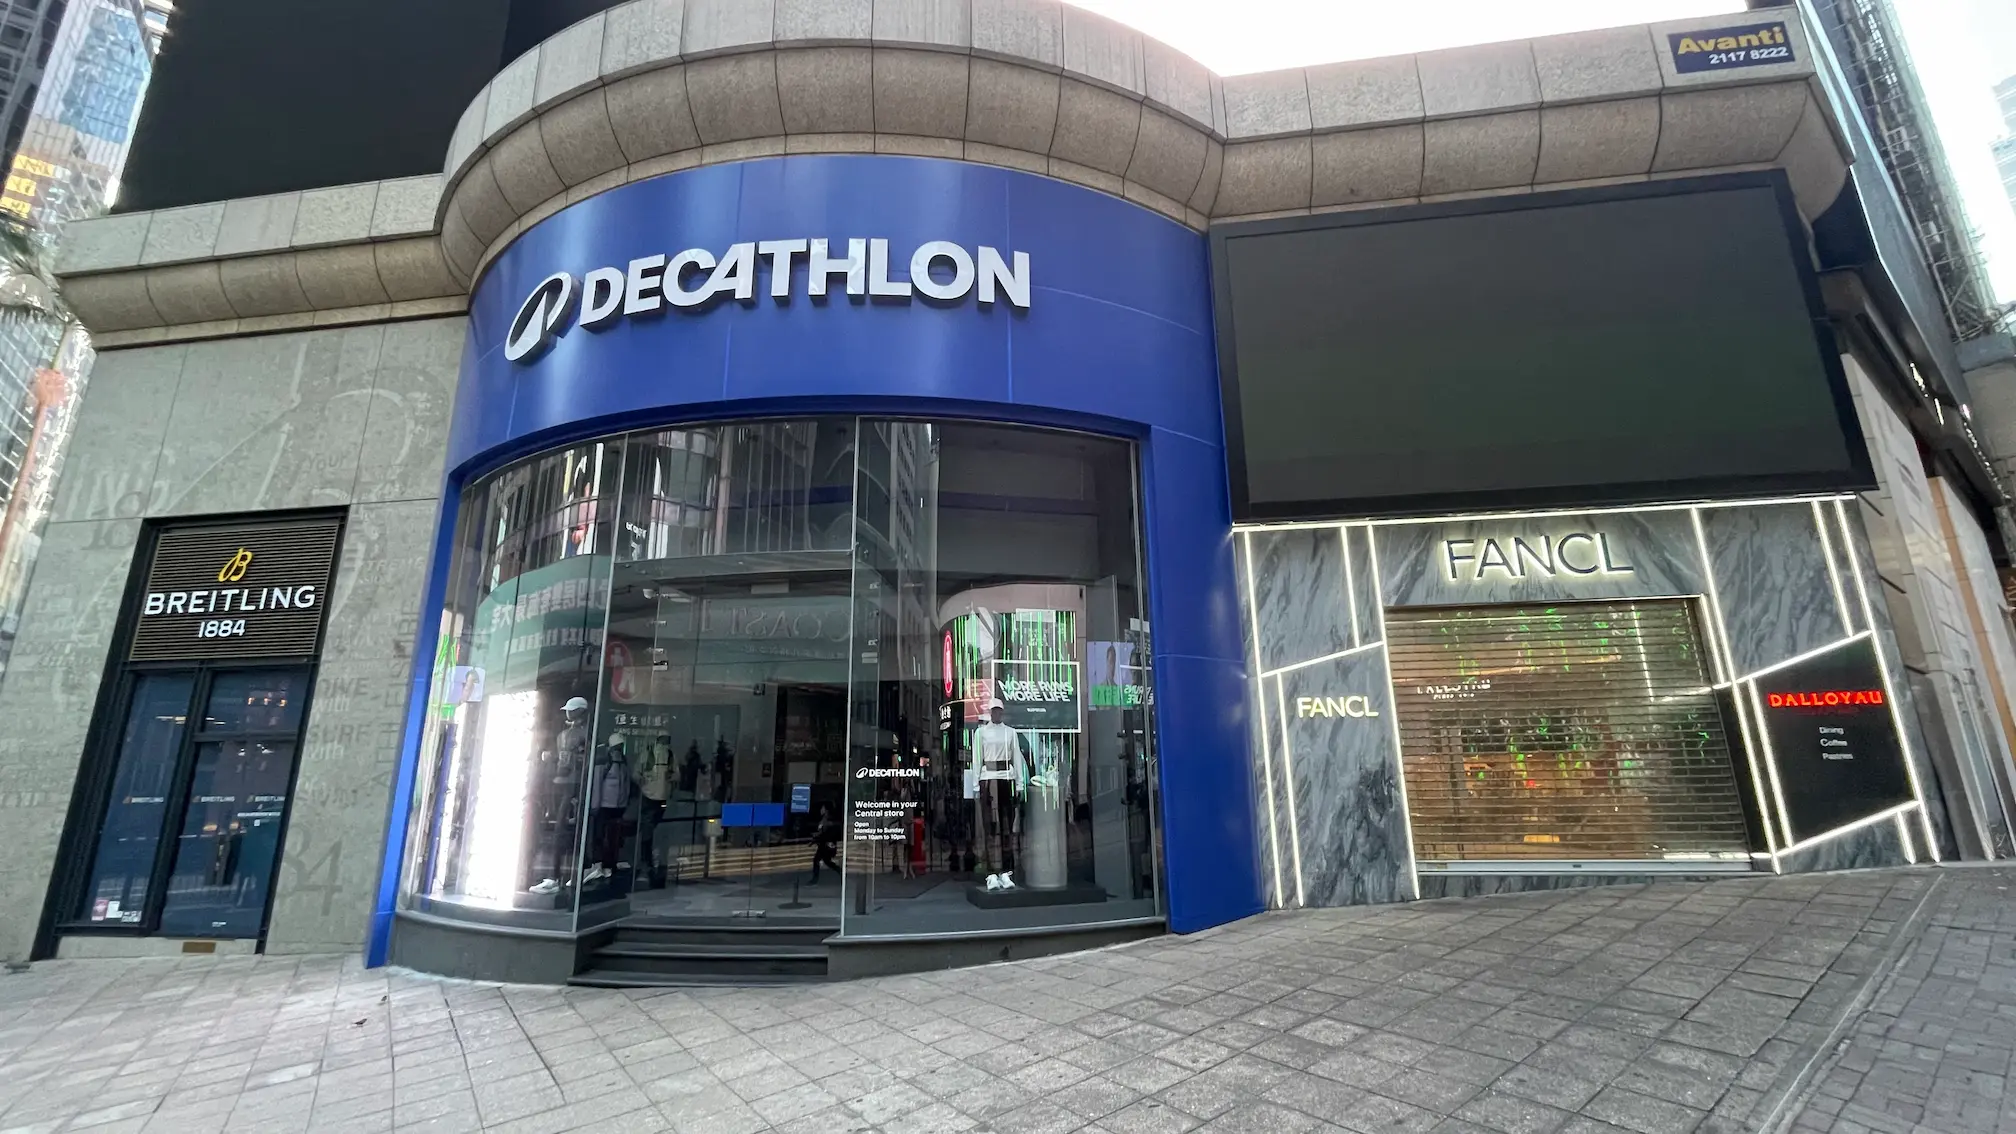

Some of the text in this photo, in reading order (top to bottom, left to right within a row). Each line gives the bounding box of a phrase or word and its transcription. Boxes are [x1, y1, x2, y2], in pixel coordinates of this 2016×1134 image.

[1678, 26, 1785, 55] Avanti
[1708, 47, 1789, 64] 2117 8222
[578, 237, 1031, 327] DECATHLON
[1441, 532, 1635, 582] FANCL
[144, 585, 316, 615] BREITLING
[198, 619, 246, 638] 1884
[998, 680, 1074, 692] MORE RUNS
[1003, 690, 1071, 702] MORE LIFE
[1769, 690, 1883, 707] DALLOYAU
[1297, 695, 1379, 718] FANCL
[868, 769, 920, 777] DECATHLON
